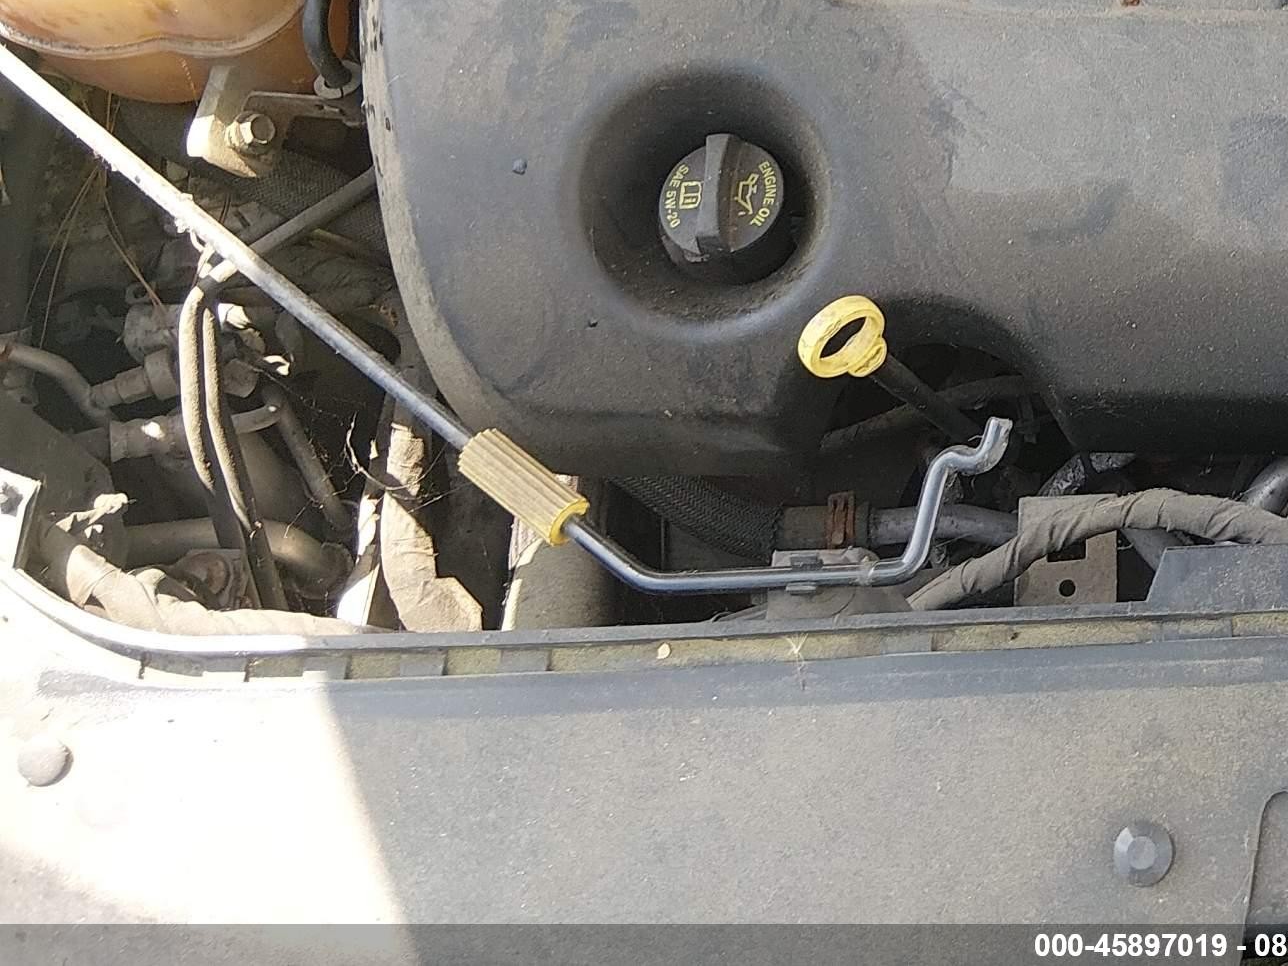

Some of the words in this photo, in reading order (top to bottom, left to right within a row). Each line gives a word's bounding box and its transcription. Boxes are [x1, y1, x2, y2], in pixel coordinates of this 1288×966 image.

[669, 164, 689, 188] SAE
[758, 161, 777, 206] ENGINE
[664, 190, 681, 229] 5W-20
[749, 207, 771, 228] OIL
